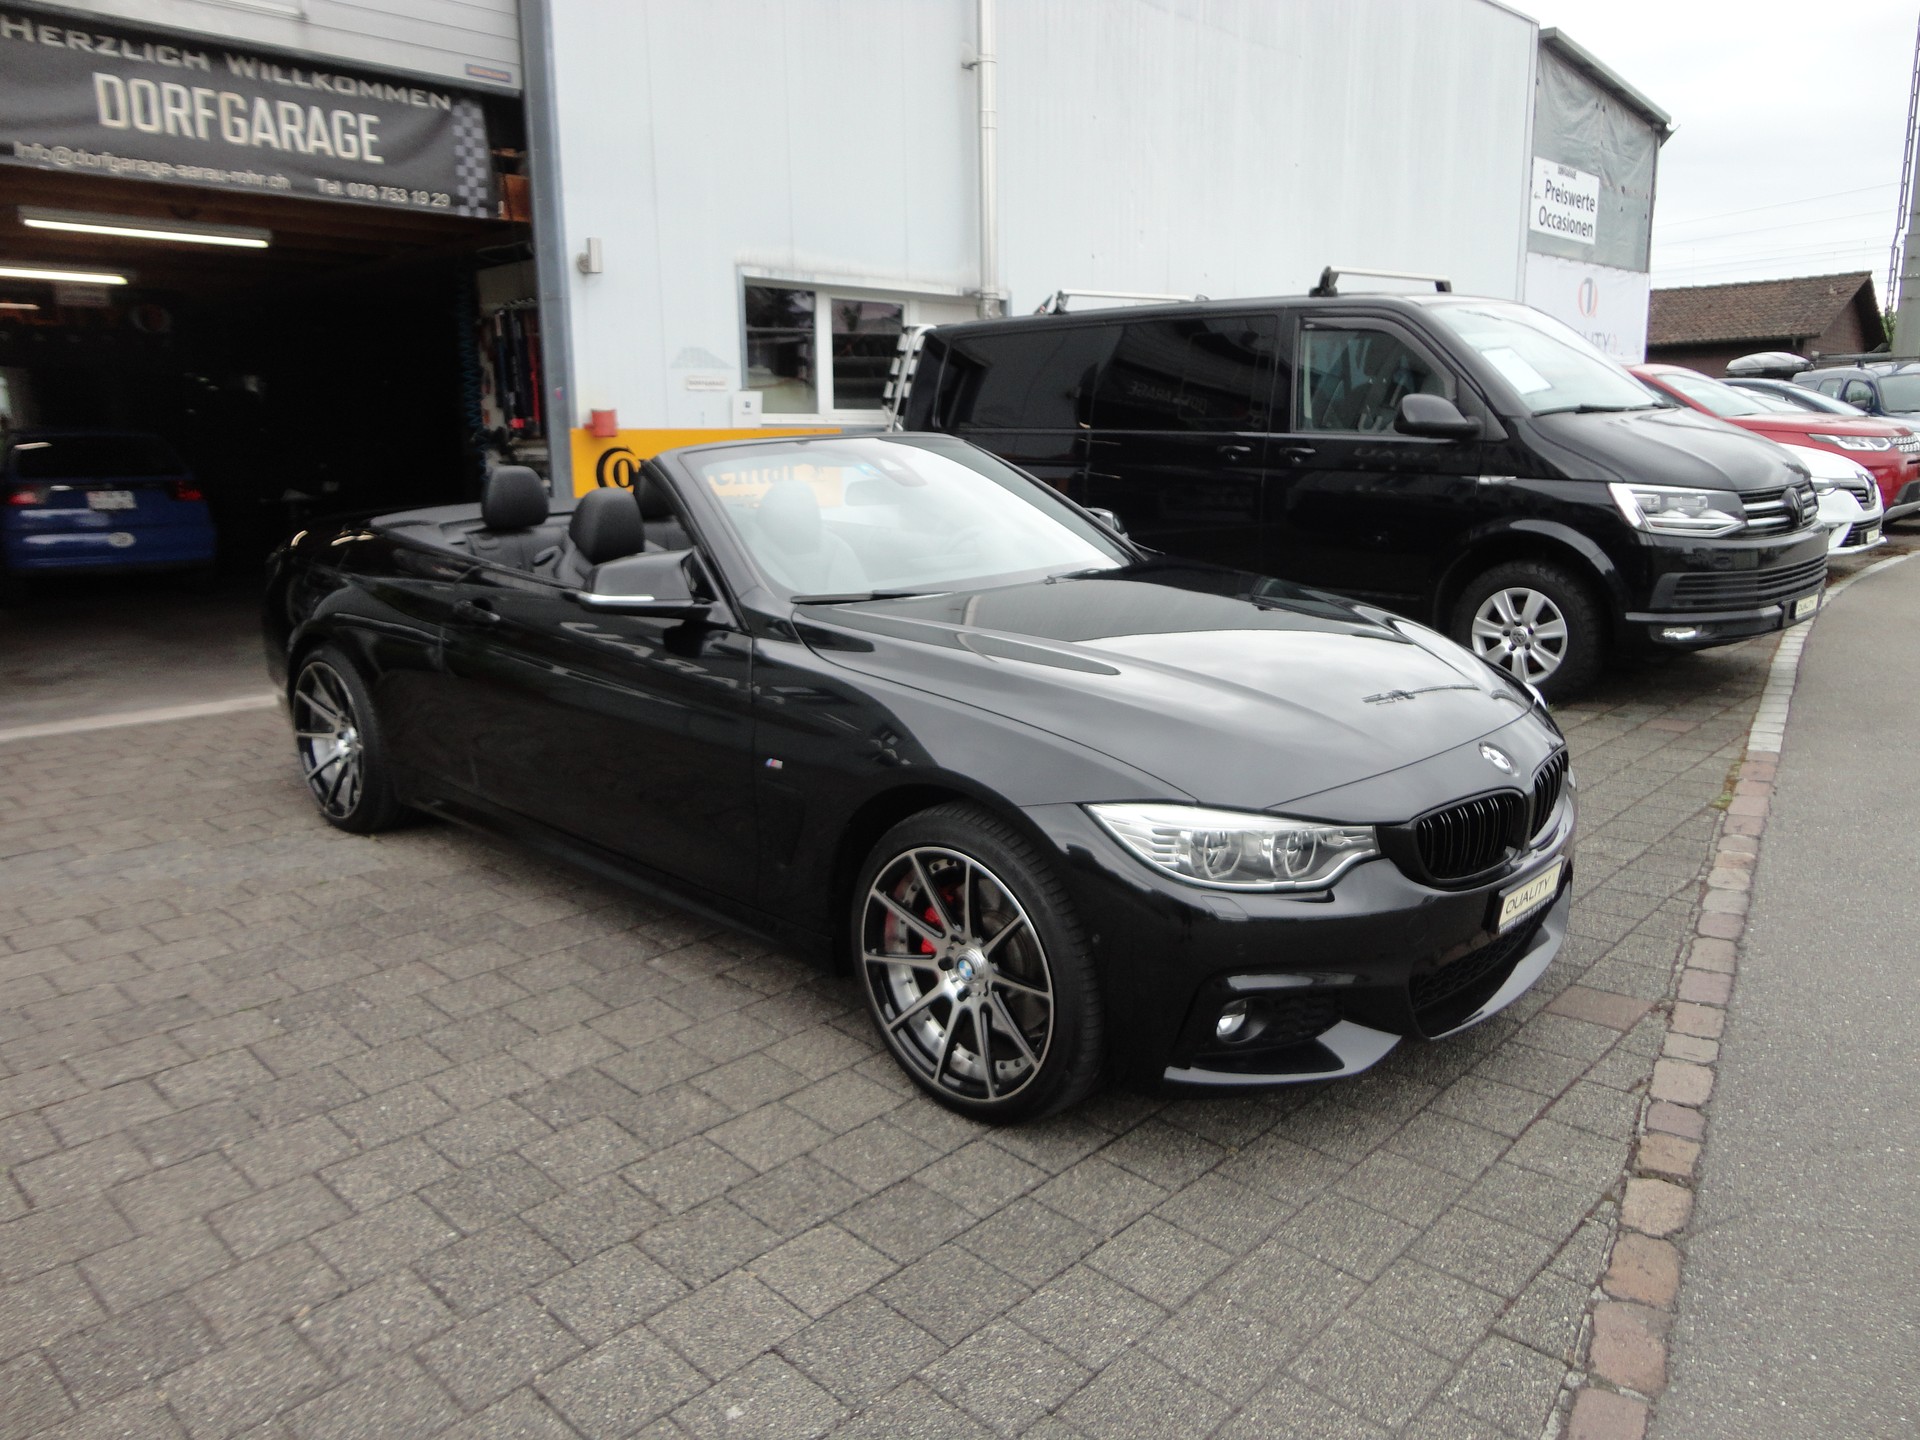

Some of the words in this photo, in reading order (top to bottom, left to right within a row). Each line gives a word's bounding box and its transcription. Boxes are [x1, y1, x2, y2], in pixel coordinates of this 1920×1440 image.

[0, 14, 210, 72] HERZLICH
[225, 53, 451, 111] WILLKOMMEN
[93, 71, 385, 165] DORFGARAGE
[431, 192, 451, 208] 29
[1545, 179, 1595, 212] Preiswerte
[1538, 205, 1593, 237] Occasionen
